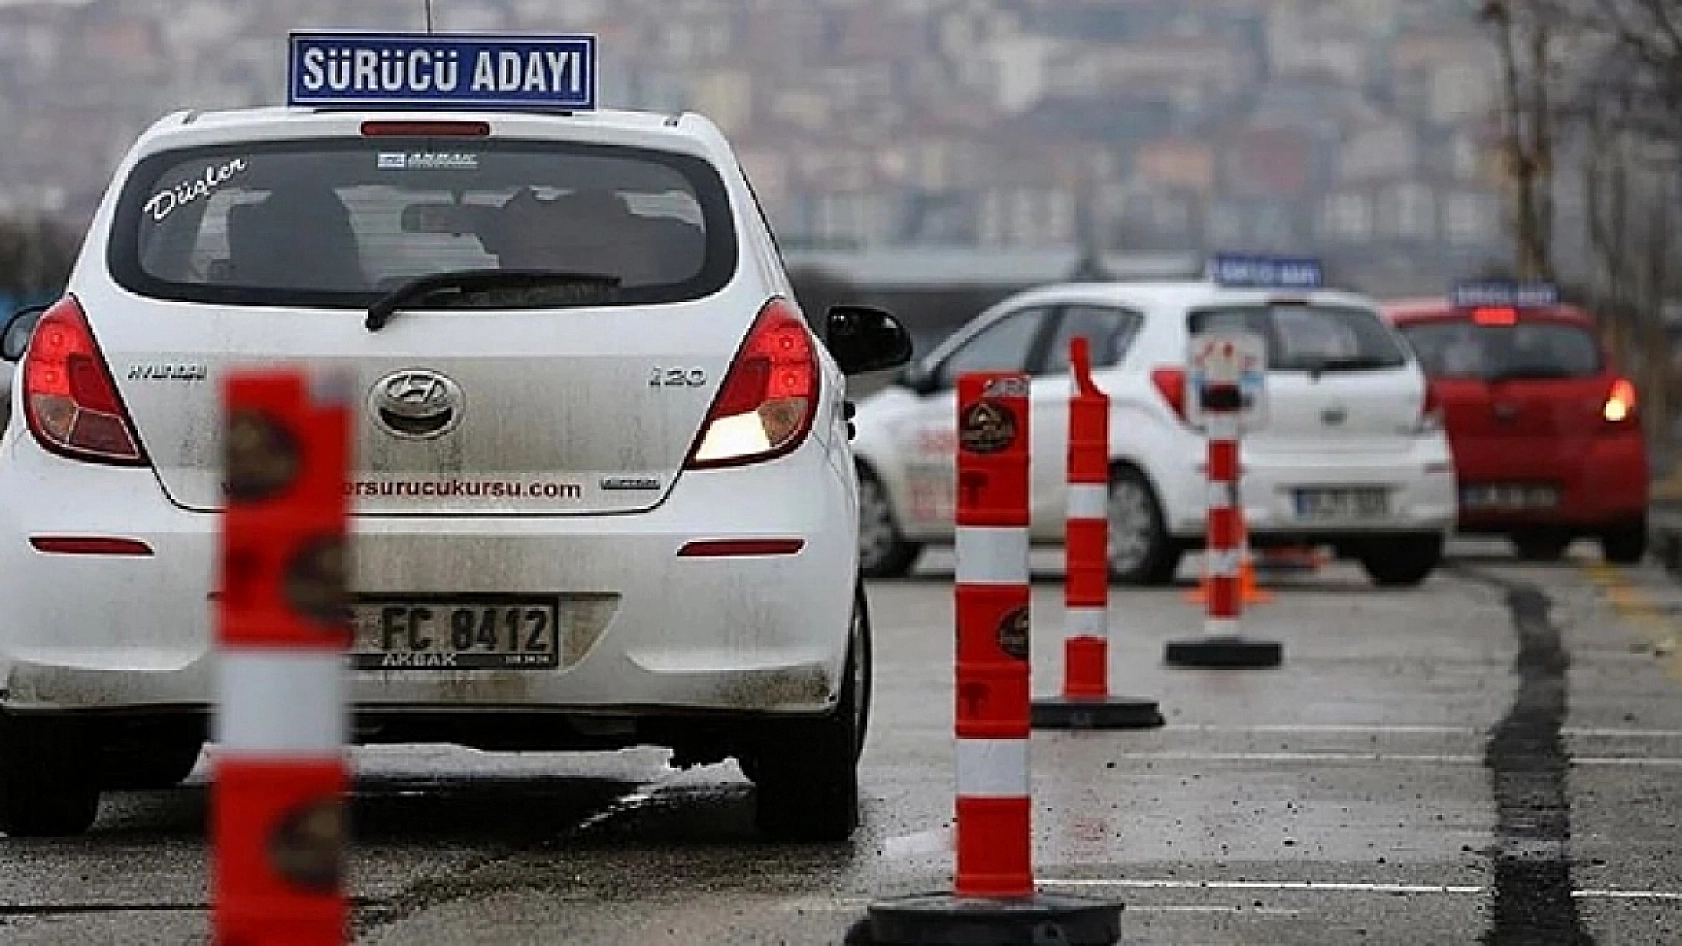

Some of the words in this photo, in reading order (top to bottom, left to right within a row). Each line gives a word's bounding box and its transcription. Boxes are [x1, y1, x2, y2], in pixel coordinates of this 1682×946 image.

[303, 47, 458, 92] SÜRÜCÜ
[470, 51, 580, 93] ADAYI
[451, 607, 548, 651] 8412
